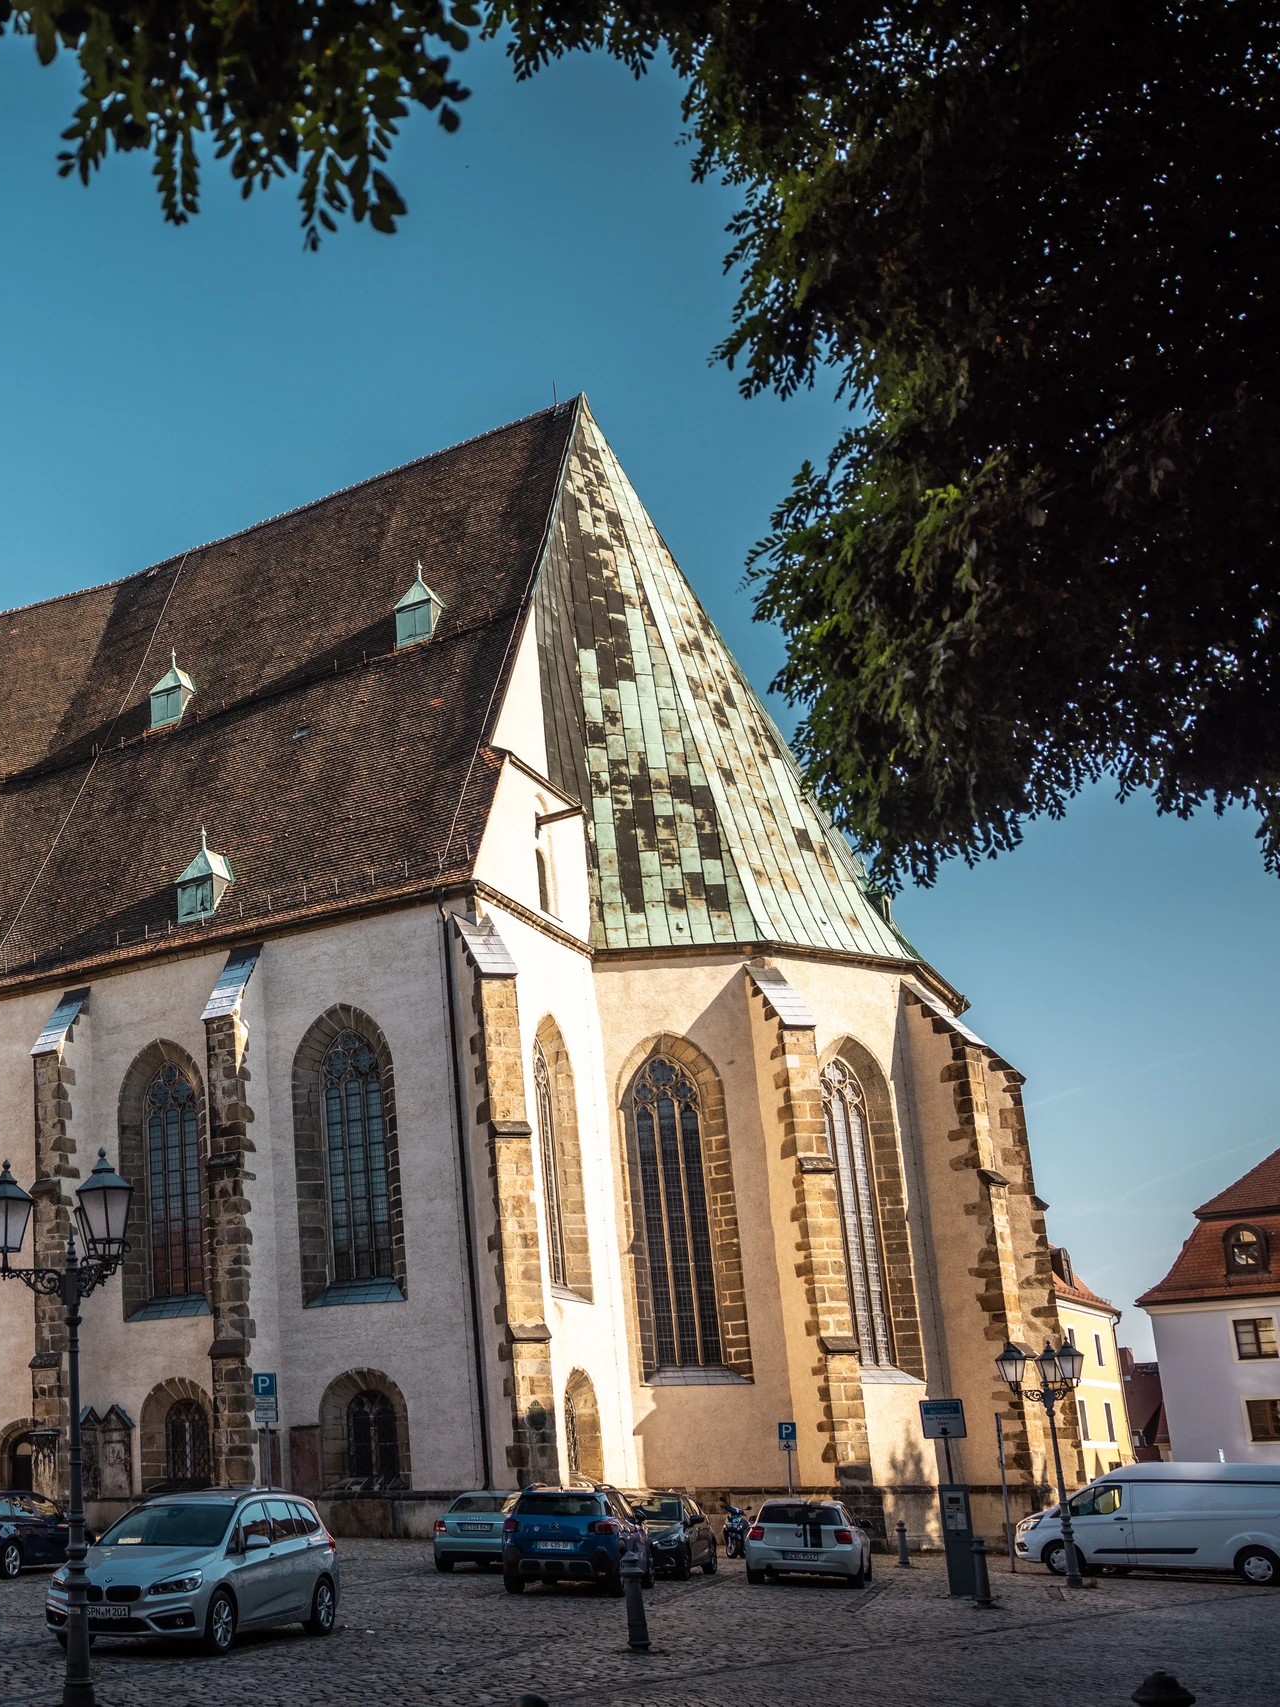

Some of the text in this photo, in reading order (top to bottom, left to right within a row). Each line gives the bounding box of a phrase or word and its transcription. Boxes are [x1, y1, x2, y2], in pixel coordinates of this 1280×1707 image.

[258, 1376, 270, 1394] P
[782, 1424, 792, 1438] P
[87, 1607, 100, 1616] SPN
[112, 1608, 127, 1617] 201
